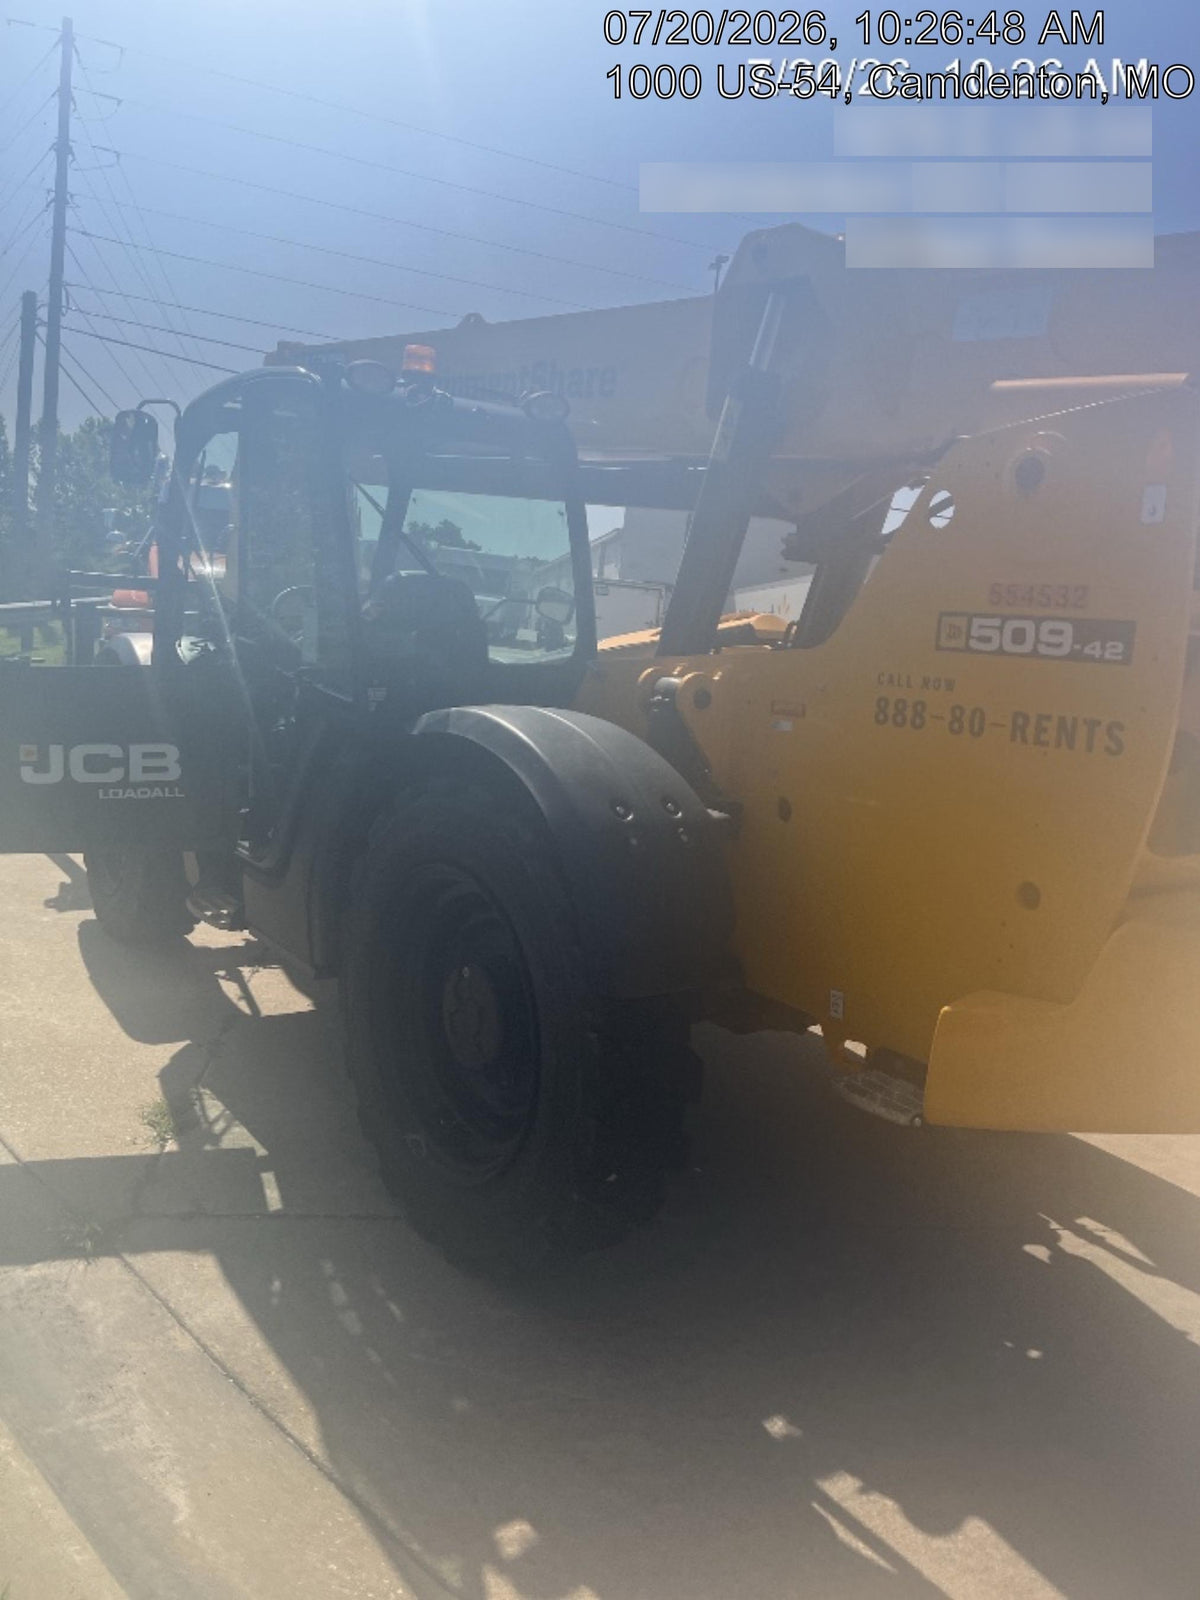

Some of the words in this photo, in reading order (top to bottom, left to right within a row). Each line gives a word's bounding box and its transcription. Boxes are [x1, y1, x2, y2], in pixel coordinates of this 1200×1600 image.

[877, 671, 913, 690] CALL
[920, 674, 957, 693] NOW
[873, 695, 1127, 757] 888-80-RENTS
[19, 742, 182, 785] JCB
[98, 786, 186, 800] LOADALL
